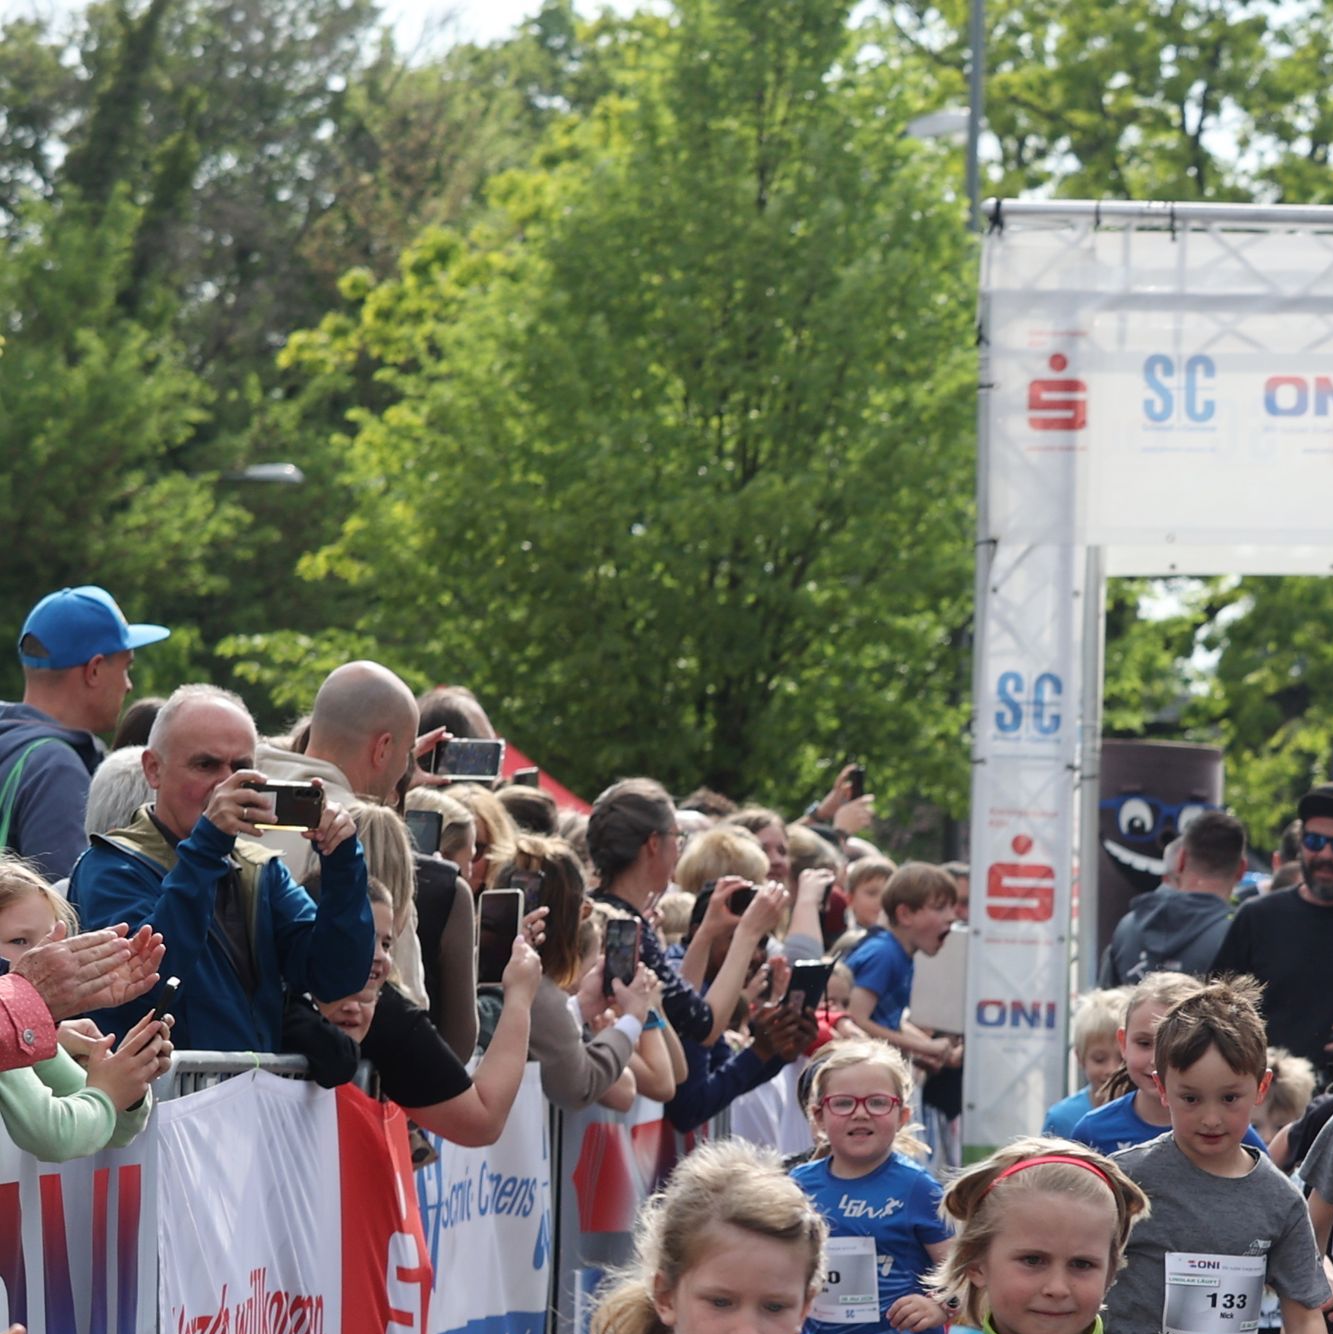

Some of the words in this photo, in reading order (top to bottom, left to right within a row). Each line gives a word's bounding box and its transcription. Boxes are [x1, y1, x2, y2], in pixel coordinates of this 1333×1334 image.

[1142, 353, 1216, 424] SC
[994, 671, 1063, 736] SC
[975, 999, 1057, 1030] ONI
[1197, 1260, 1220, 1270] ONI
[1206, 1293, 1248, 1309] 133
